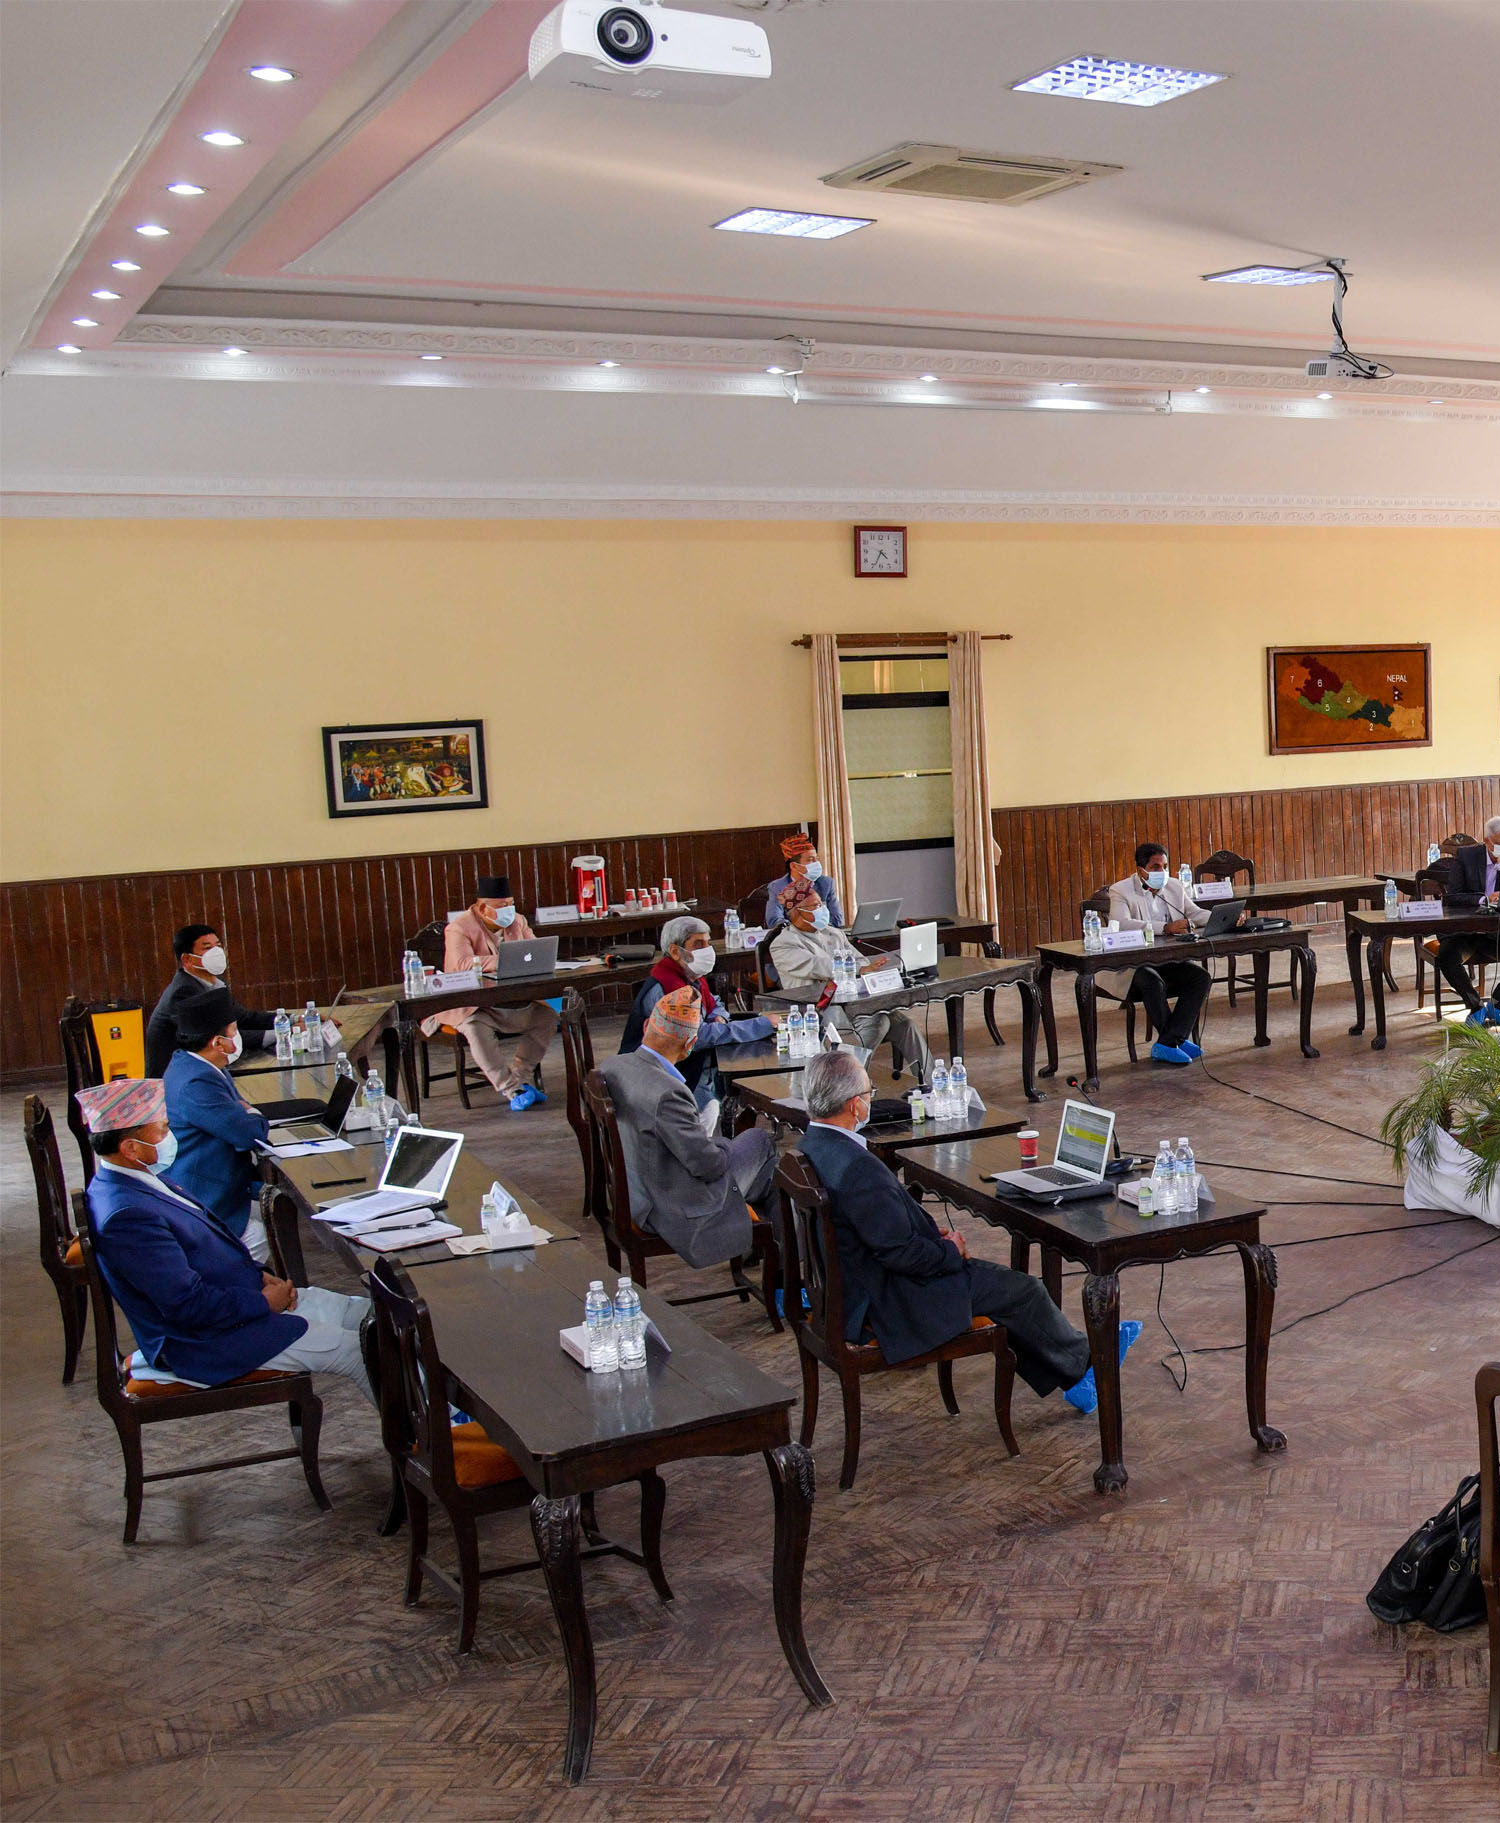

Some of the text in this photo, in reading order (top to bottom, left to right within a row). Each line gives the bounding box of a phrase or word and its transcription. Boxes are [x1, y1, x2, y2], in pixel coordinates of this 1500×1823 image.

[1290, 675, 1295, 683] 7
[1386, 674, 1408, 683] NEPAL
[1317, 679, 1323, 688] 6
[1346, 696, 1351, 704] 4
[1325, 703, 1331, 712] 5
[1371, 710, 1377, 718] 3
[1369, 722, 1374, 732] 2
